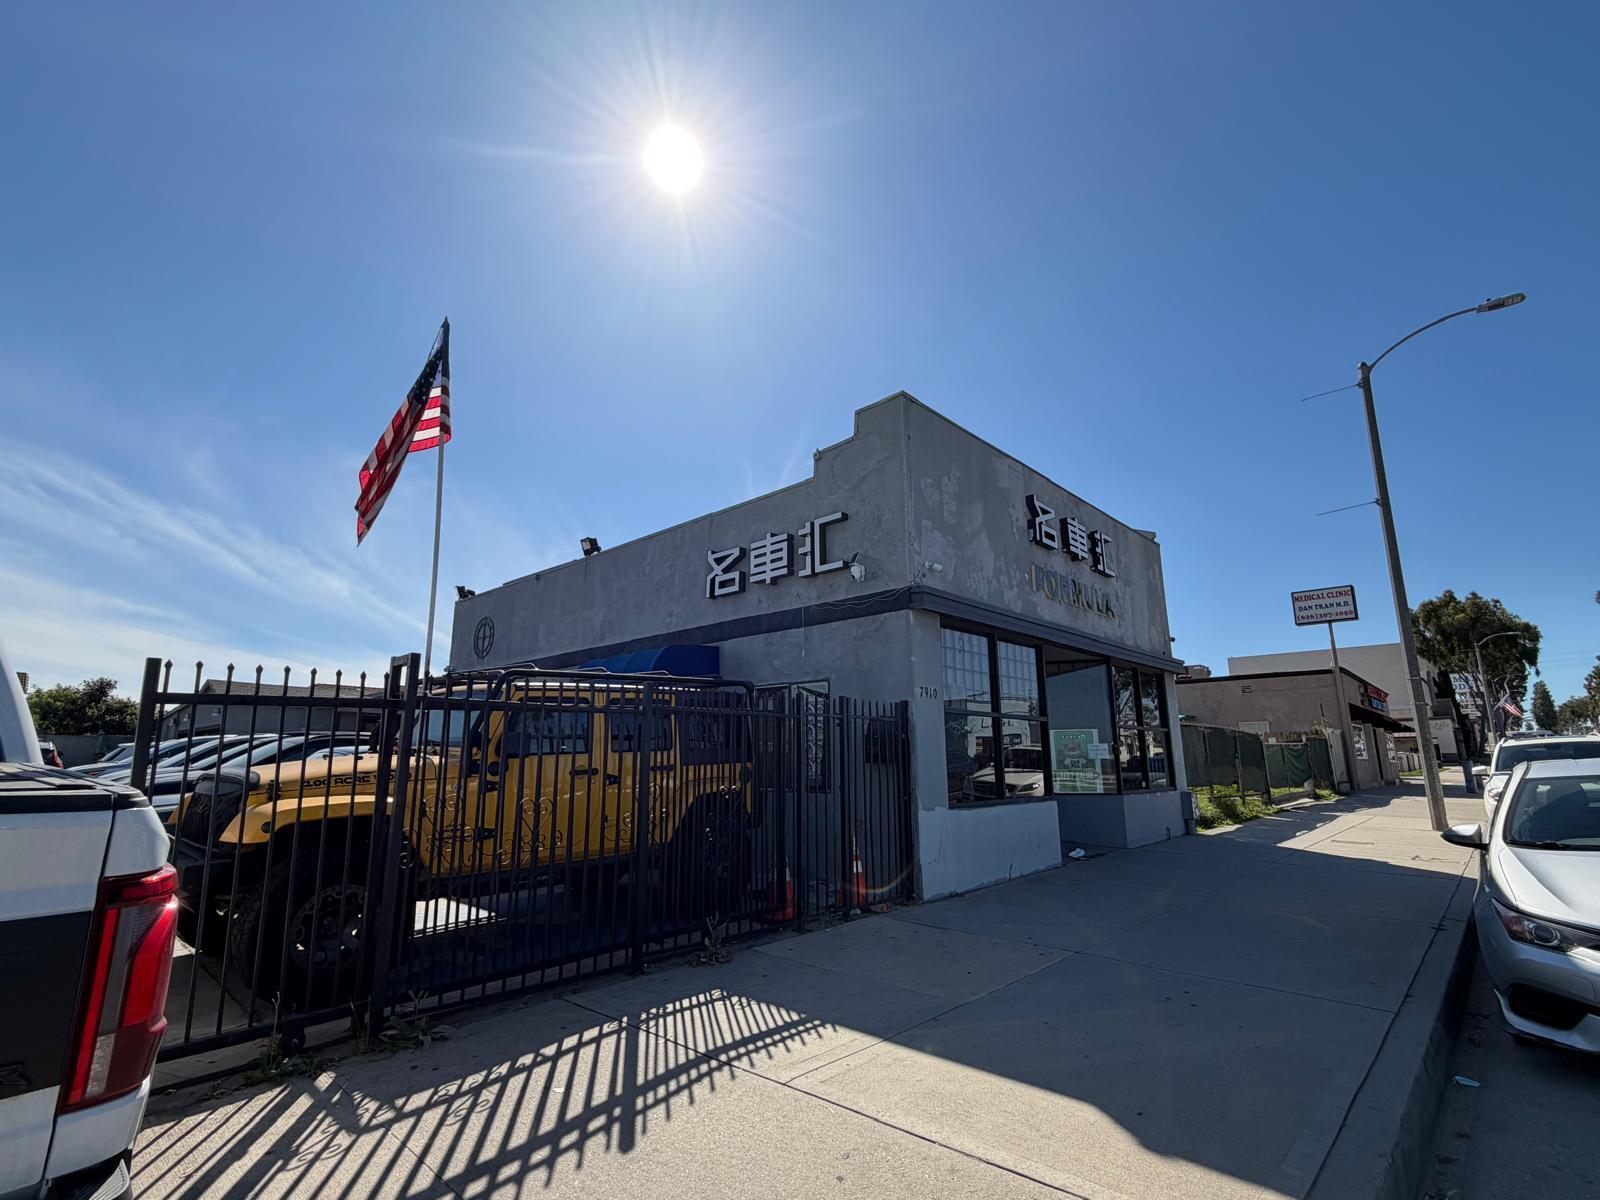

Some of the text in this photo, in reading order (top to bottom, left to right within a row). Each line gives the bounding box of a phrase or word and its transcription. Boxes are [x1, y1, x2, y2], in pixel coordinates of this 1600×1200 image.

[1026, 494, 1115, 578] 名車汇
[706, 511, 848, 598] 名車汇
[1031, 564, 1116, 618] FORMULA
[1294, 590, 1351, 602] MEDICAL CLINIC
[1314, 602, 1334, 610] TRAN
[919, 686, 938, 699] 7910
